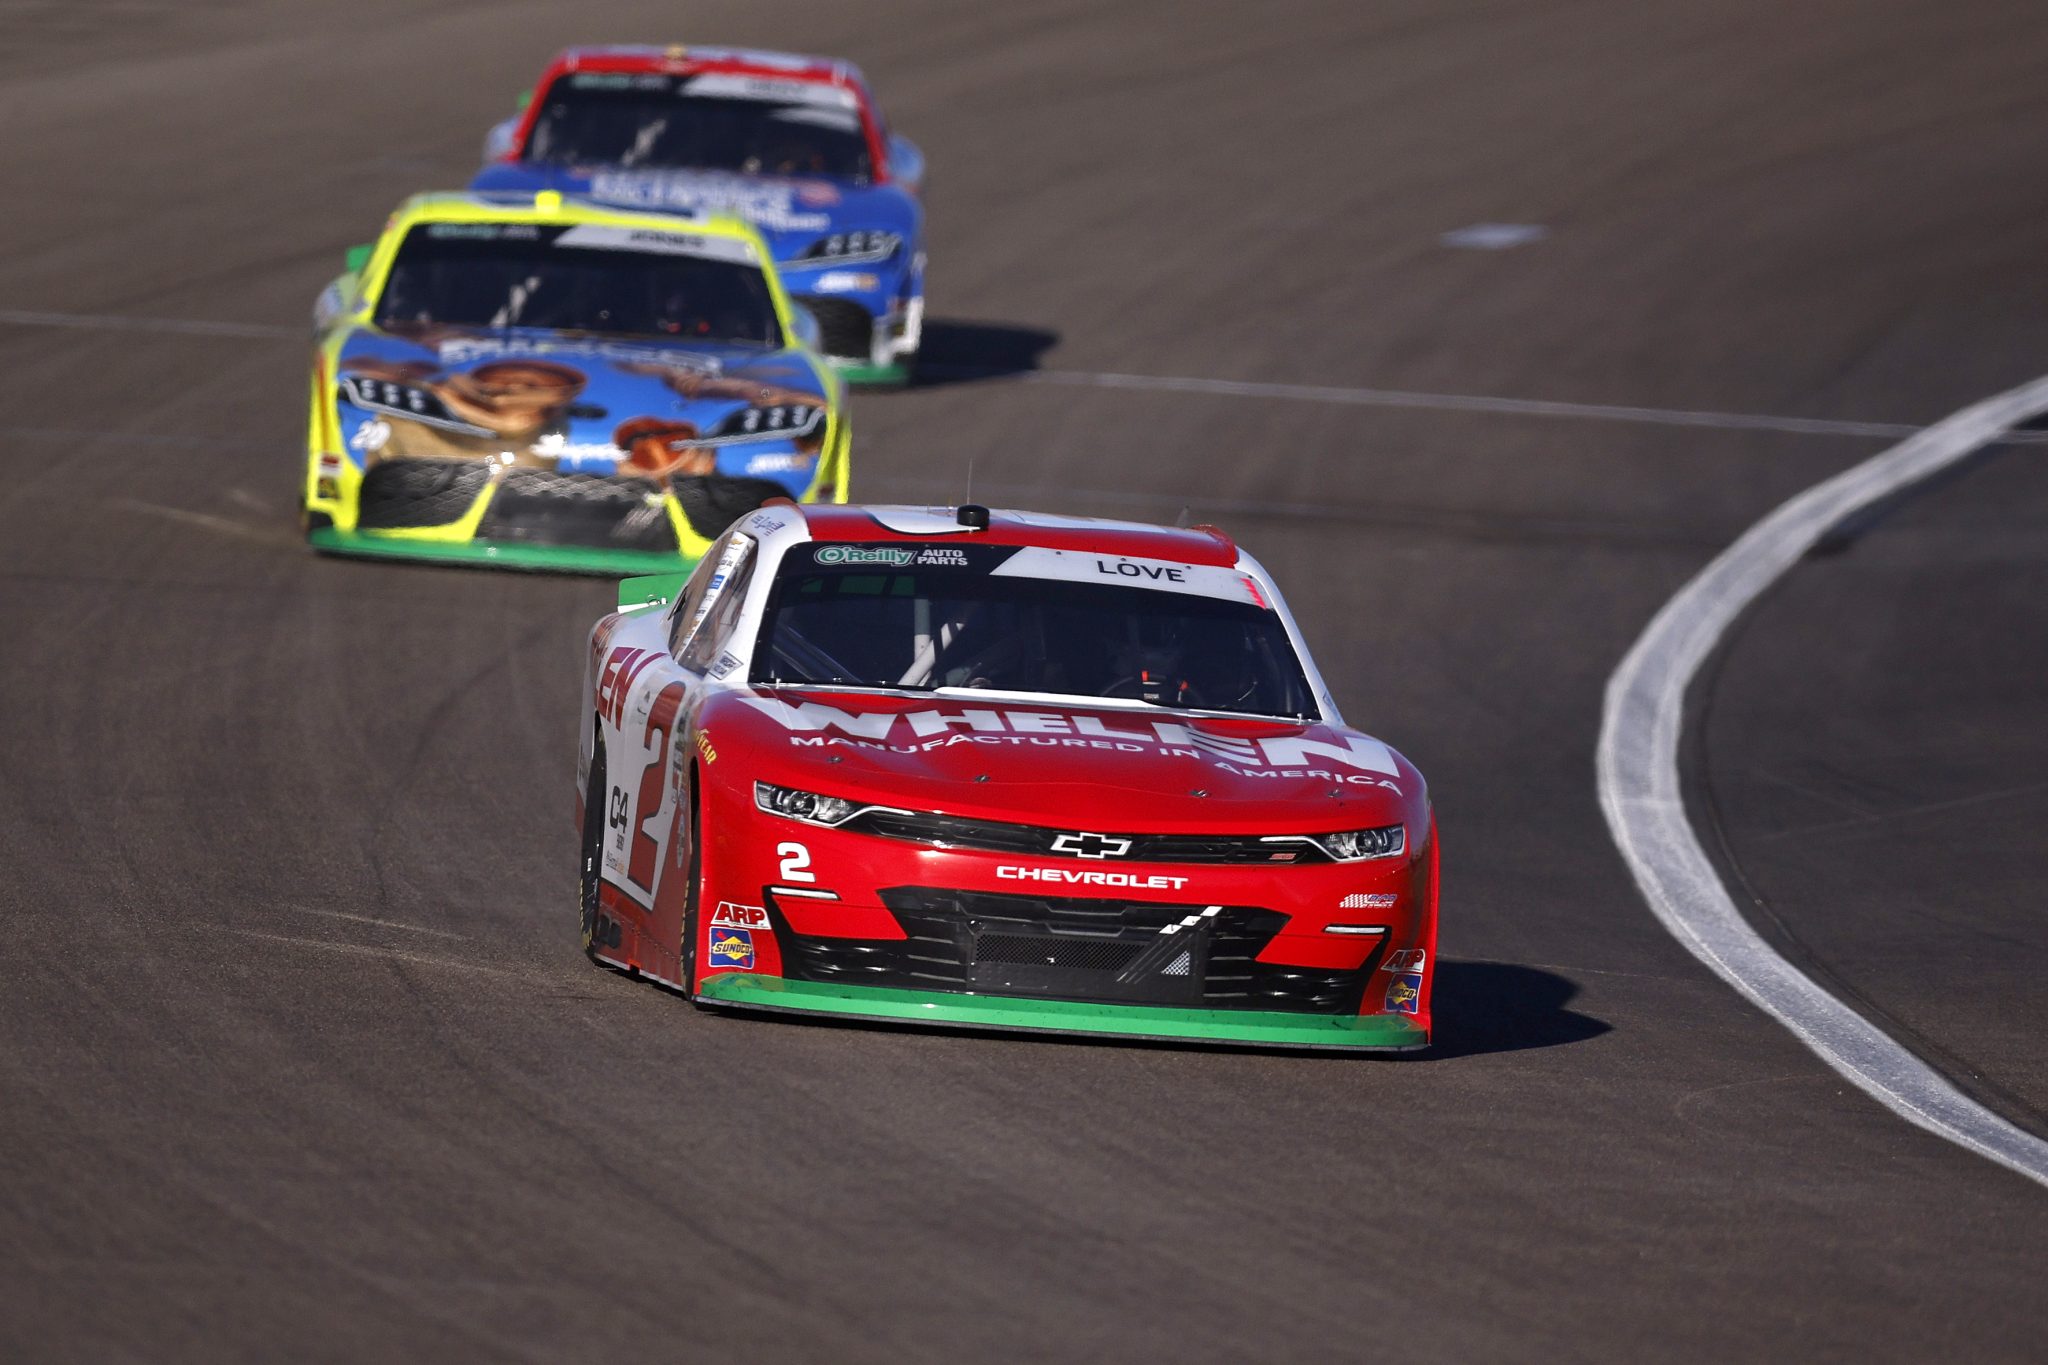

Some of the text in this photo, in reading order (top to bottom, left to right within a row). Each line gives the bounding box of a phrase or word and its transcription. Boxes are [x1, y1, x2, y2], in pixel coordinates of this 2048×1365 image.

[816, 545, 915, 566] O'Reilly
[917, 556, 968, 566] PARTS
[923, 549, 964, 558] AUTO
[1097, 560, 1186, 583] LOVE
[736, 697, 1401, 778] WHELEN
[790, 734, 1403, 797] MANUFACTURED IN AMERICA
[610, 785, 629, 834] C4
[777, 841, 816, 883] 2
[996, 865, 1189, 890] CHEVROLET
[715, 903, 766, 925] ARP
[714, 943, 750, 954] SUNOCO
